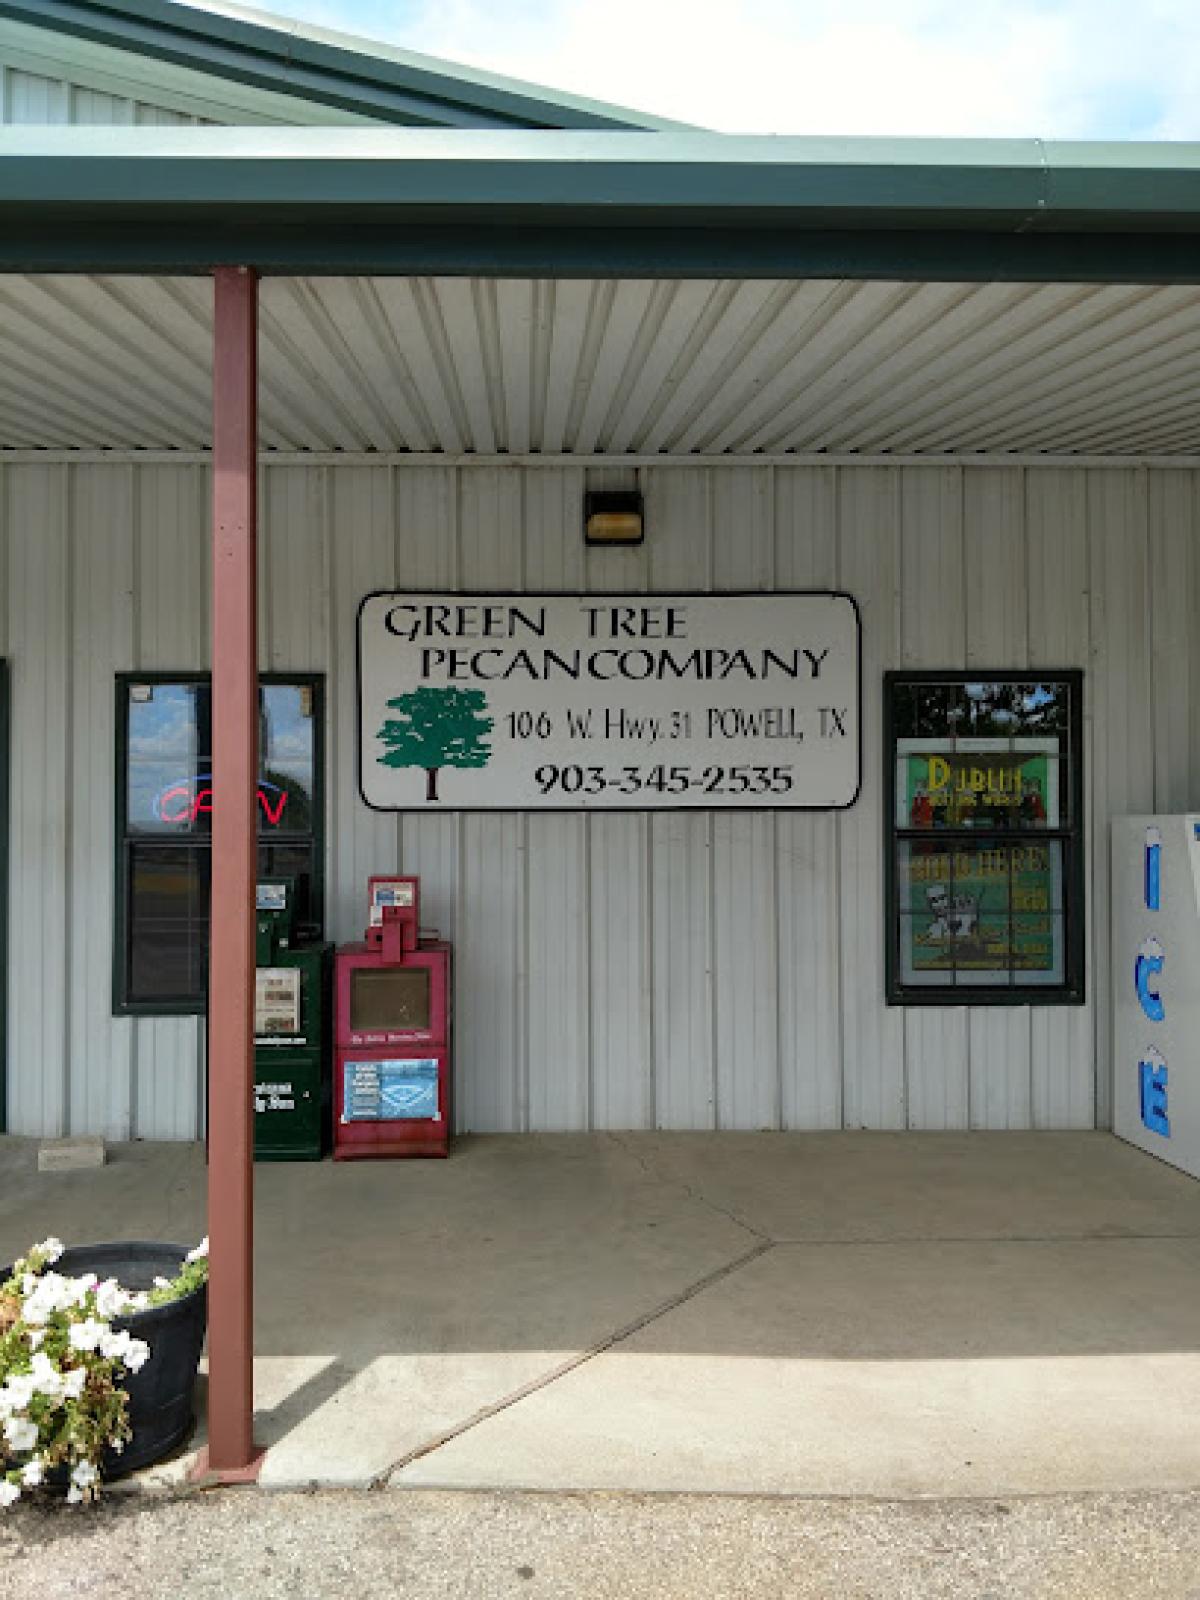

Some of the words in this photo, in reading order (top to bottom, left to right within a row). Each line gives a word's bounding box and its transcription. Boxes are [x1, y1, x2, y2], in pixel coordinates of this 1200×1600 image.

[385, 605, 546, 641] GREEN
[579, 605, 687, 639] TREE
[503, 710, 553, 740] 106
[816, 707, 849, 740] TX
[534, 763, 794, 796] 903-345-2535
[1134, 826, 1171, 1139] ICE
